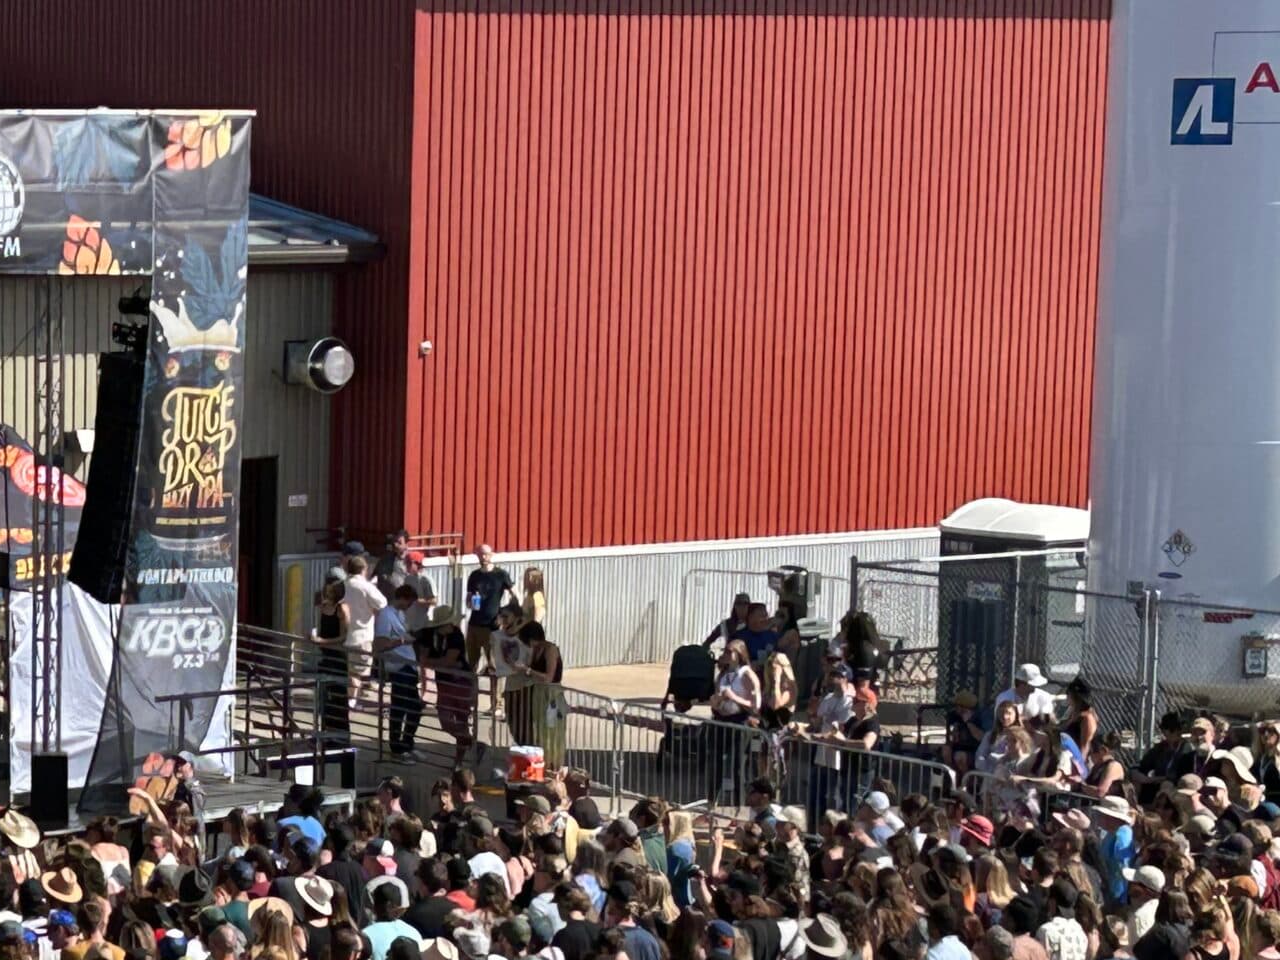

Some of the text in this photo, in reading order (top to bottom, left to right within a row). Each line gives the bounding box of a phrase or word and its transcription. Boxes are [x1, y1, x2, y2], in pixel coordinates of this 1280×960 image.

[160, 380, 236, 448] JUICE
[158, 420, 237, 493] DROP
[195, 470, 225, 509] IPA
[126, 615, 226, 658] KBCO
[172, 652, 206, 669] 97.3
